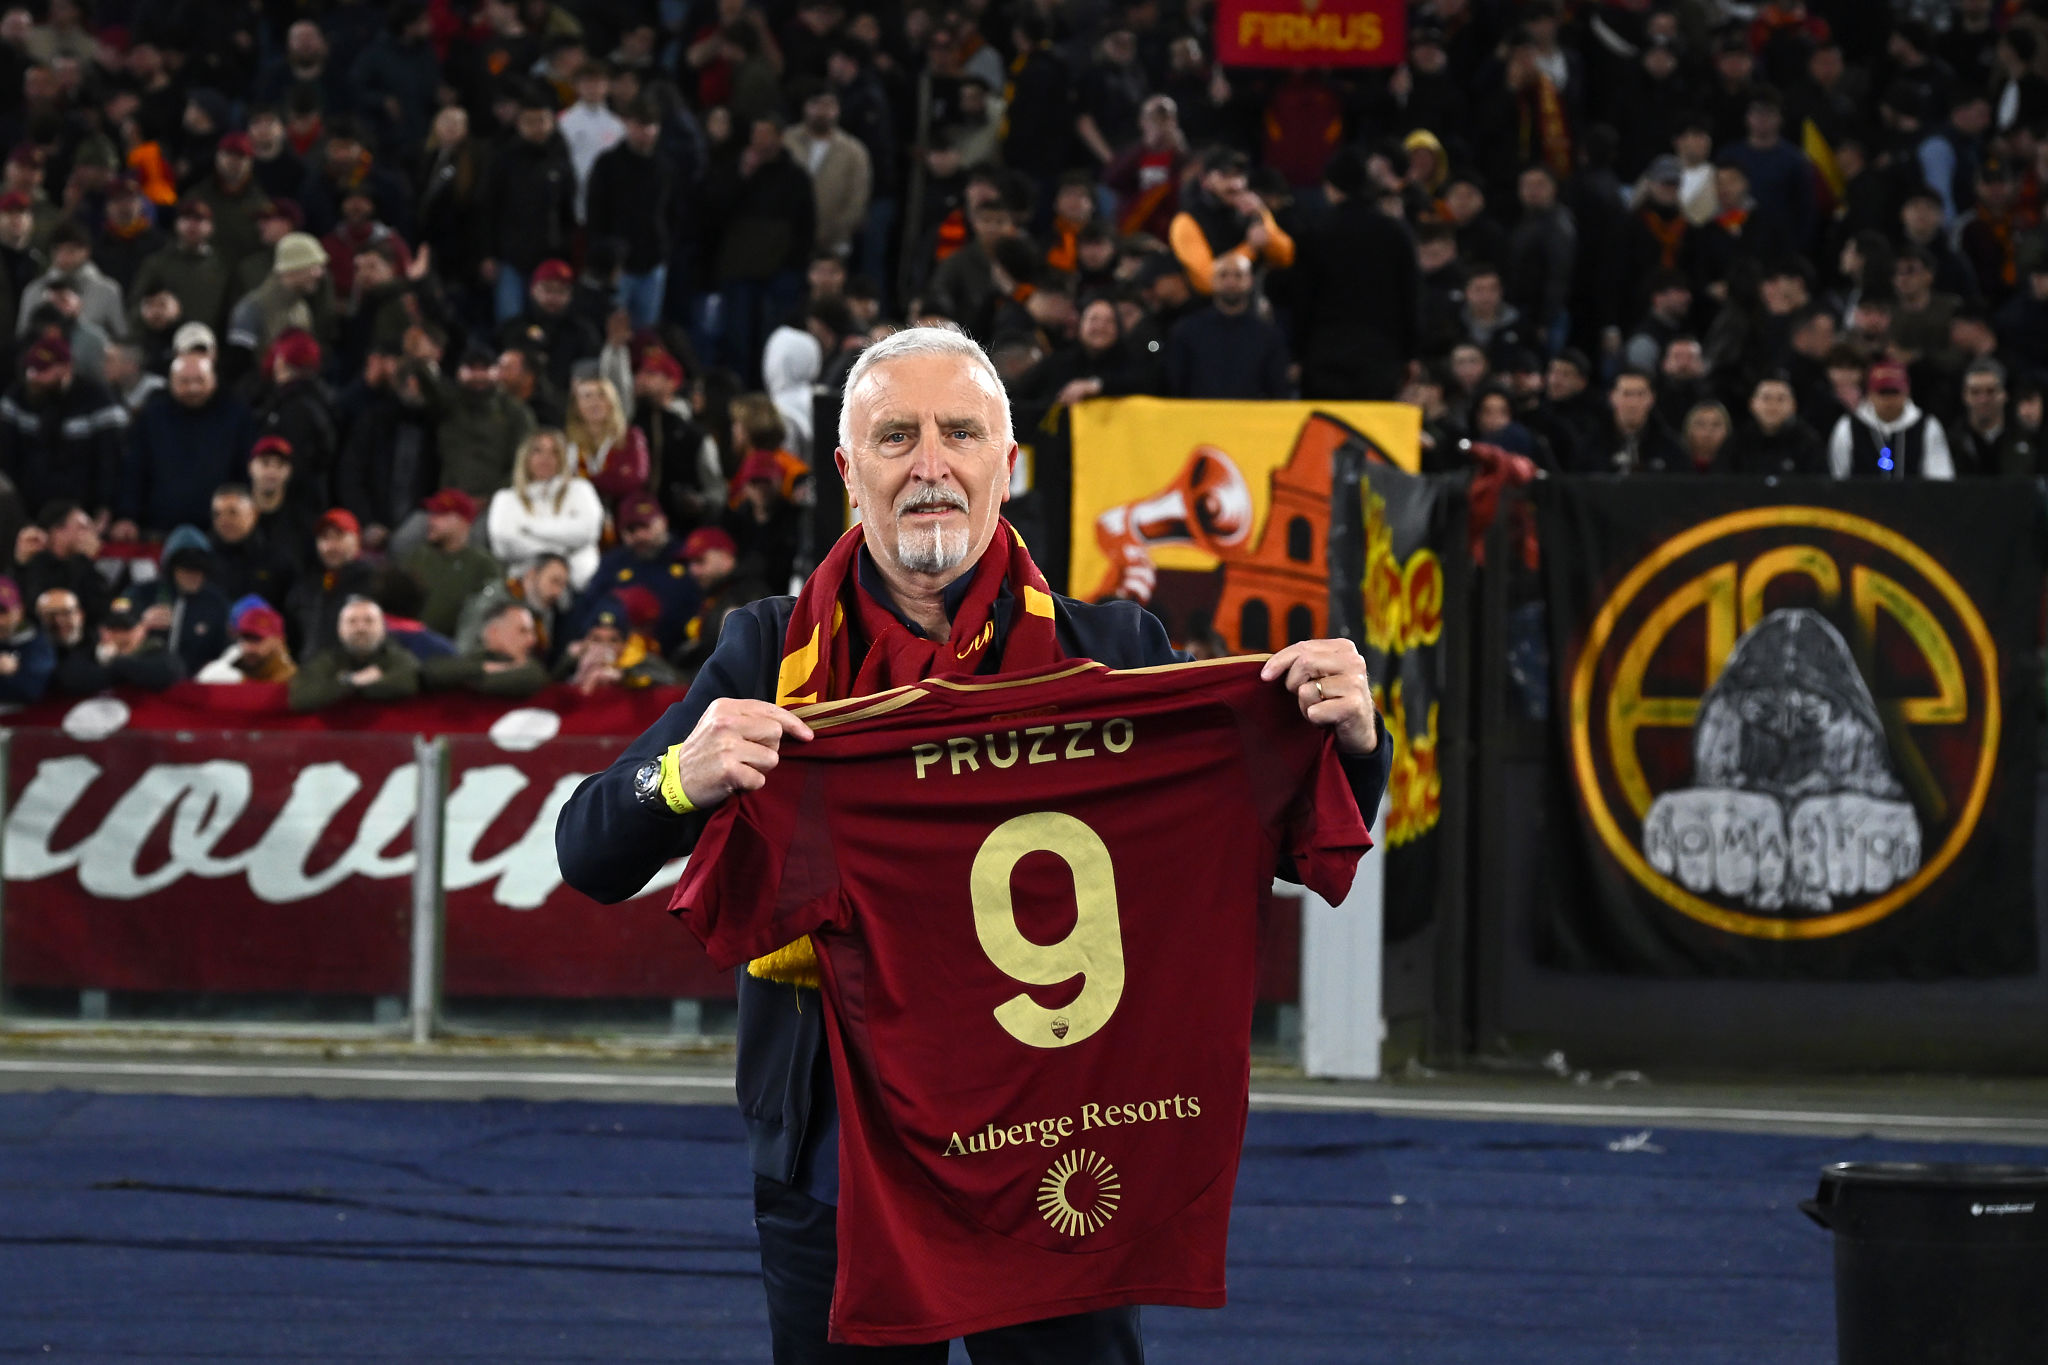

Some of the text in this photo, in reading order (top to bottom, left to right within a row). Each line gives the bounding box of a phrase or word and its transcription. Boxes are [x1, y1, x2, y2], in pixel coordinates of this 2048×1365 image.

[911, 718, 1135, 779] PRUZZO
[970, 811, 1125, 1048] 9
[942, 1094, 1201, 1156] Auberge Resorts
